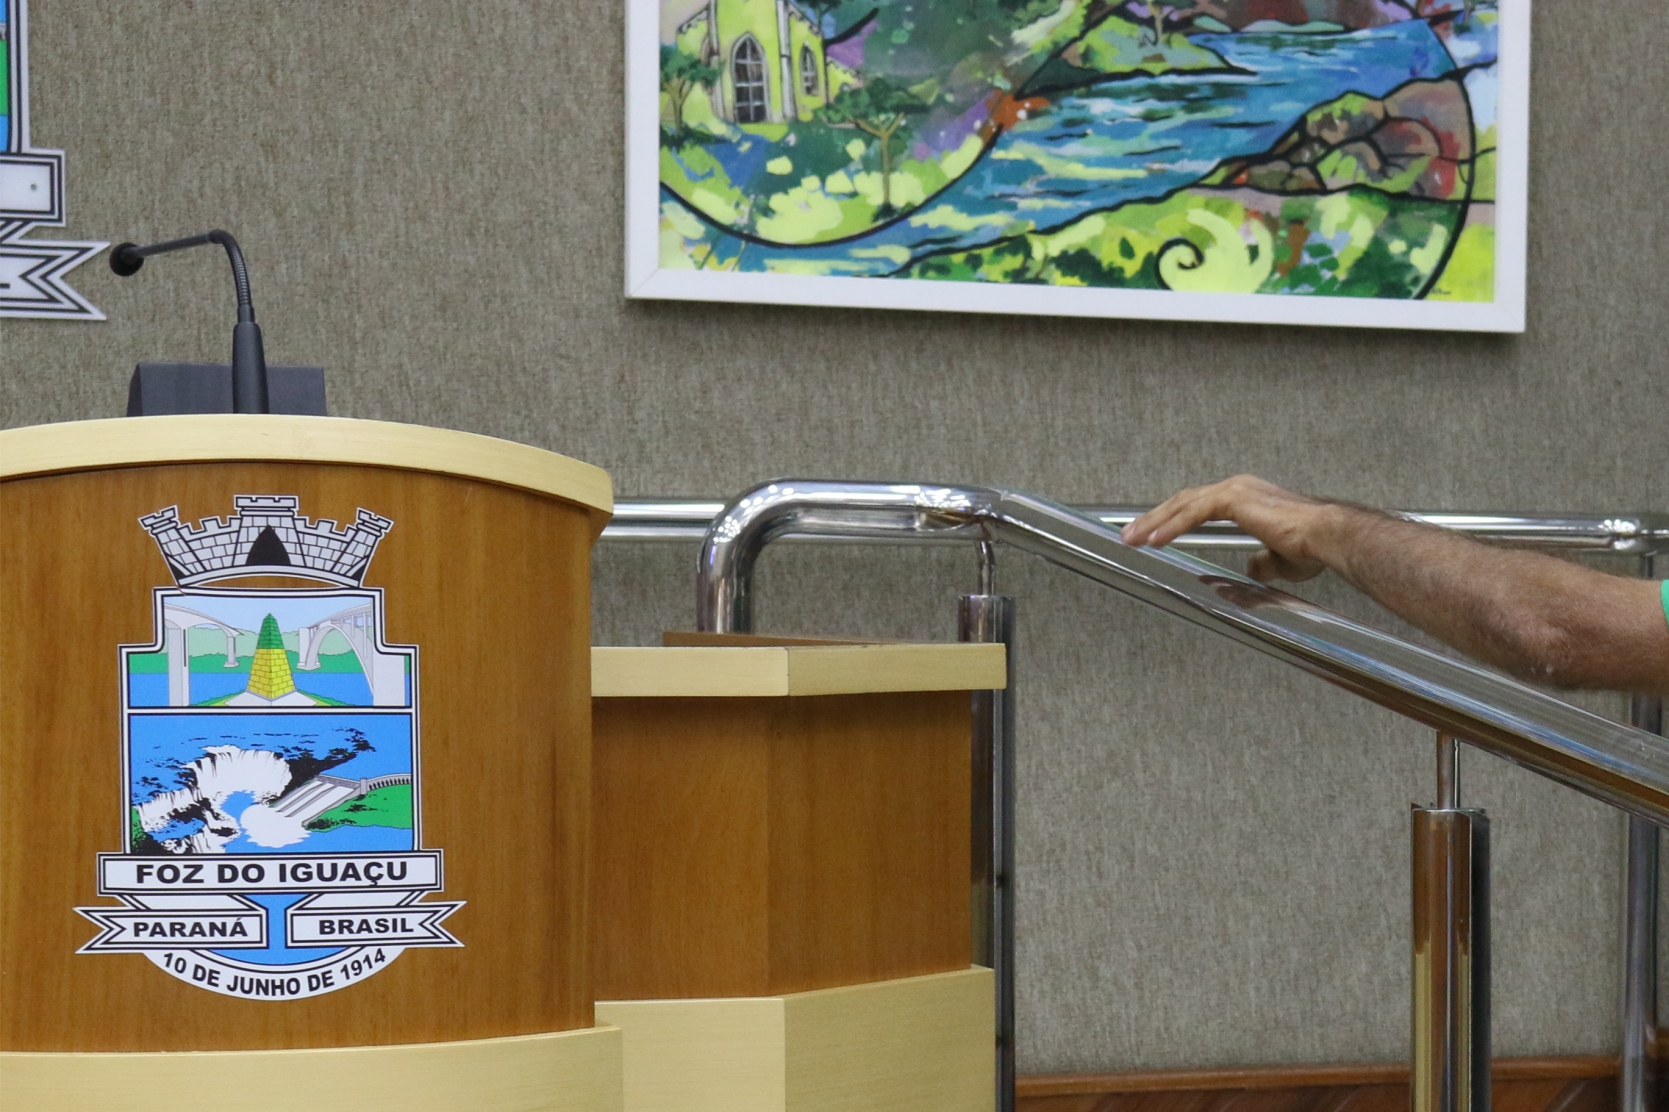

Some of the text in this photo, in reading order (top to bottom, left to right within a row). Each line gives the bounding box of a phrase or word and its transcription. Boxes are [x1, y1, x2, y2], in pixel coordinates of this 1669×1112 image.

[136, 860, 408, 887] FOZ DO IGUAÇU
[133, 917, 414, 938] PARANÁ BRASIL
[163, 948, 387, 997] 10 DE JUNHO DE 1914
